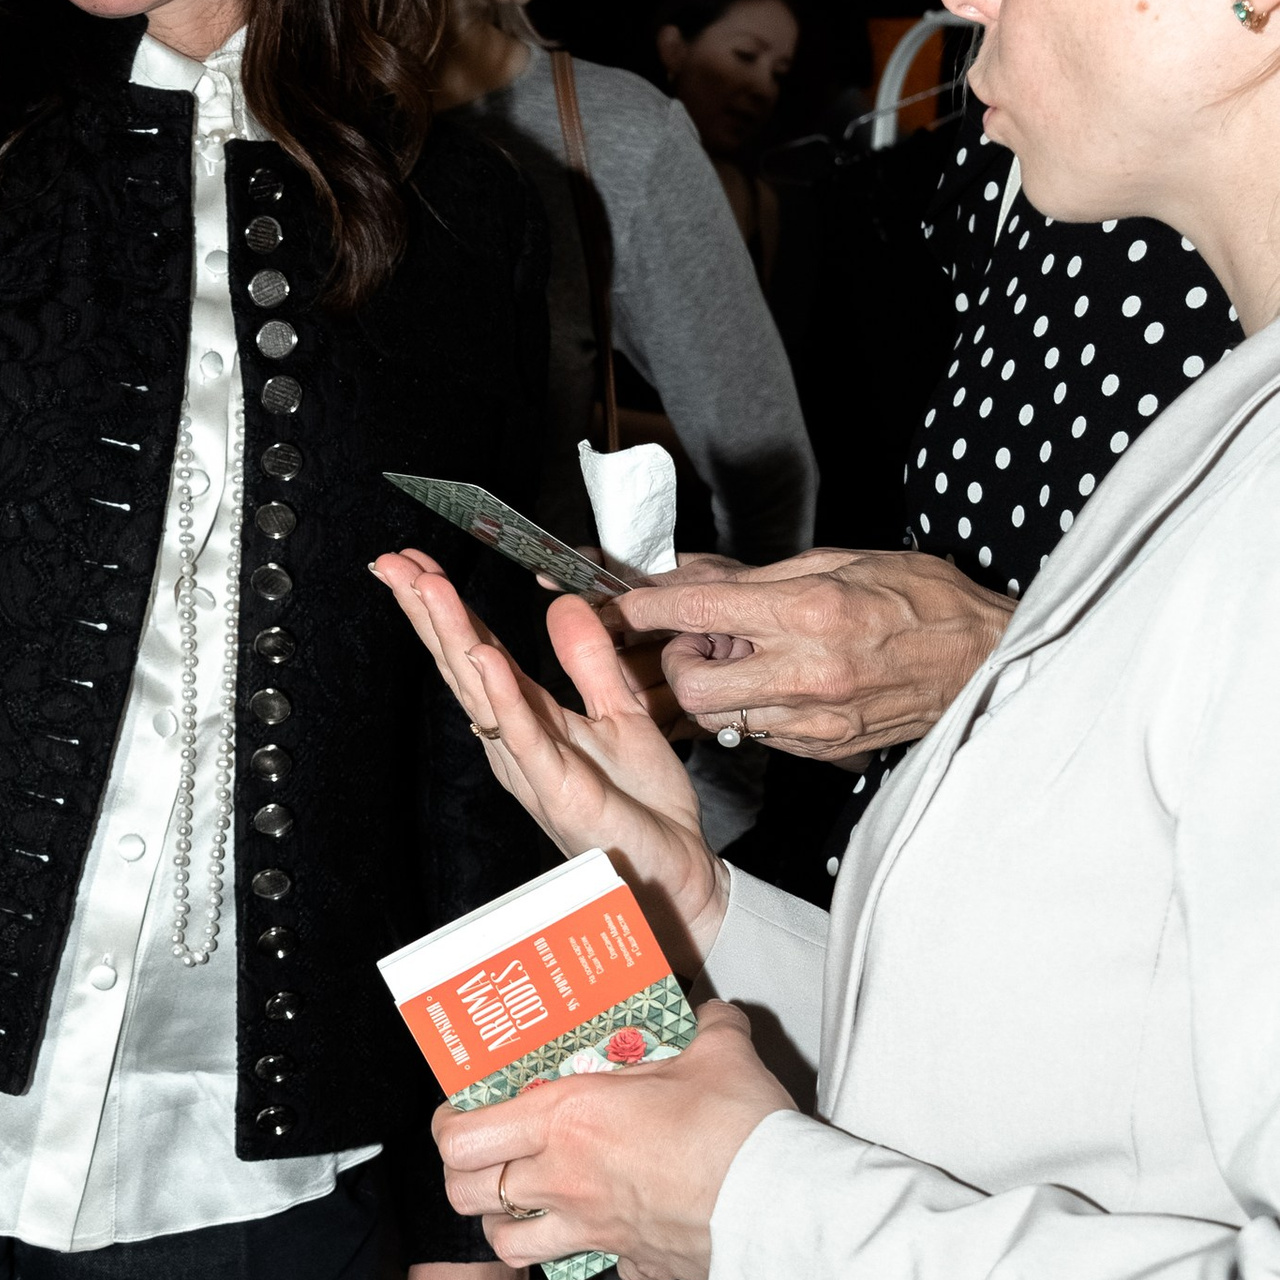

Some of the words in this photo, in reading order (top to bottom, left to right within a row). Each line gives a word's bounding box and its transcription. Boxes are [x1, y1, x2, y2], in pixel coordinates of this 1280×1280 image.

[532, 935, 557, 967] КОДОВ
[549, 966, 573, 998] АРОМА
[455, 969, 520, 1050] AROMA
[489, 957, 549, 1031] CODES
[425, 1001, 470, 1065] ИНСТРУКЦИЯ
